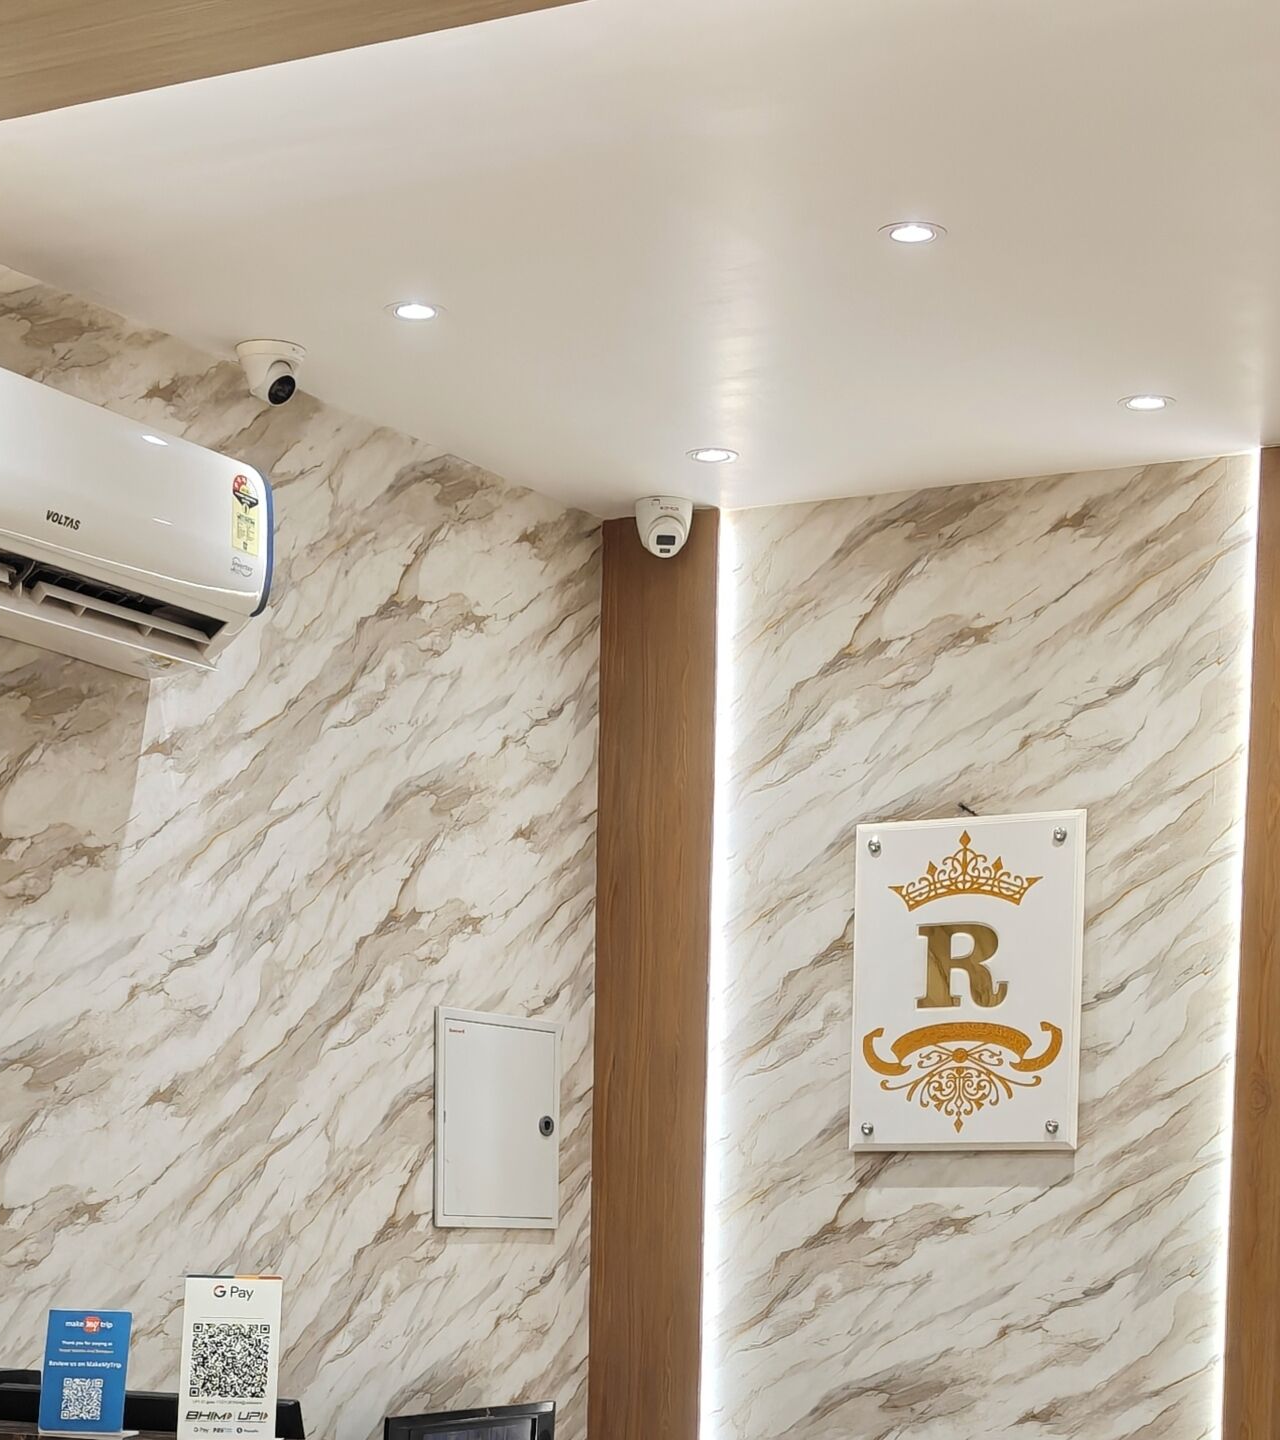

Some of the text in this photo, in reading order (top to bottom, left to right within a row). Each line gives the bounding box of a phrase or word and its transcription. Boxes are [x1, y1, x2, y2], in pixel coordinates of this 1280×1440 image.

[46, 510, 80, 530] VOLTAS
[915, 920, 1008, 1008] R
[214, 1285, 254, 1301] G Pay
[186, 1411, 264, 1420] BHIM UPI
